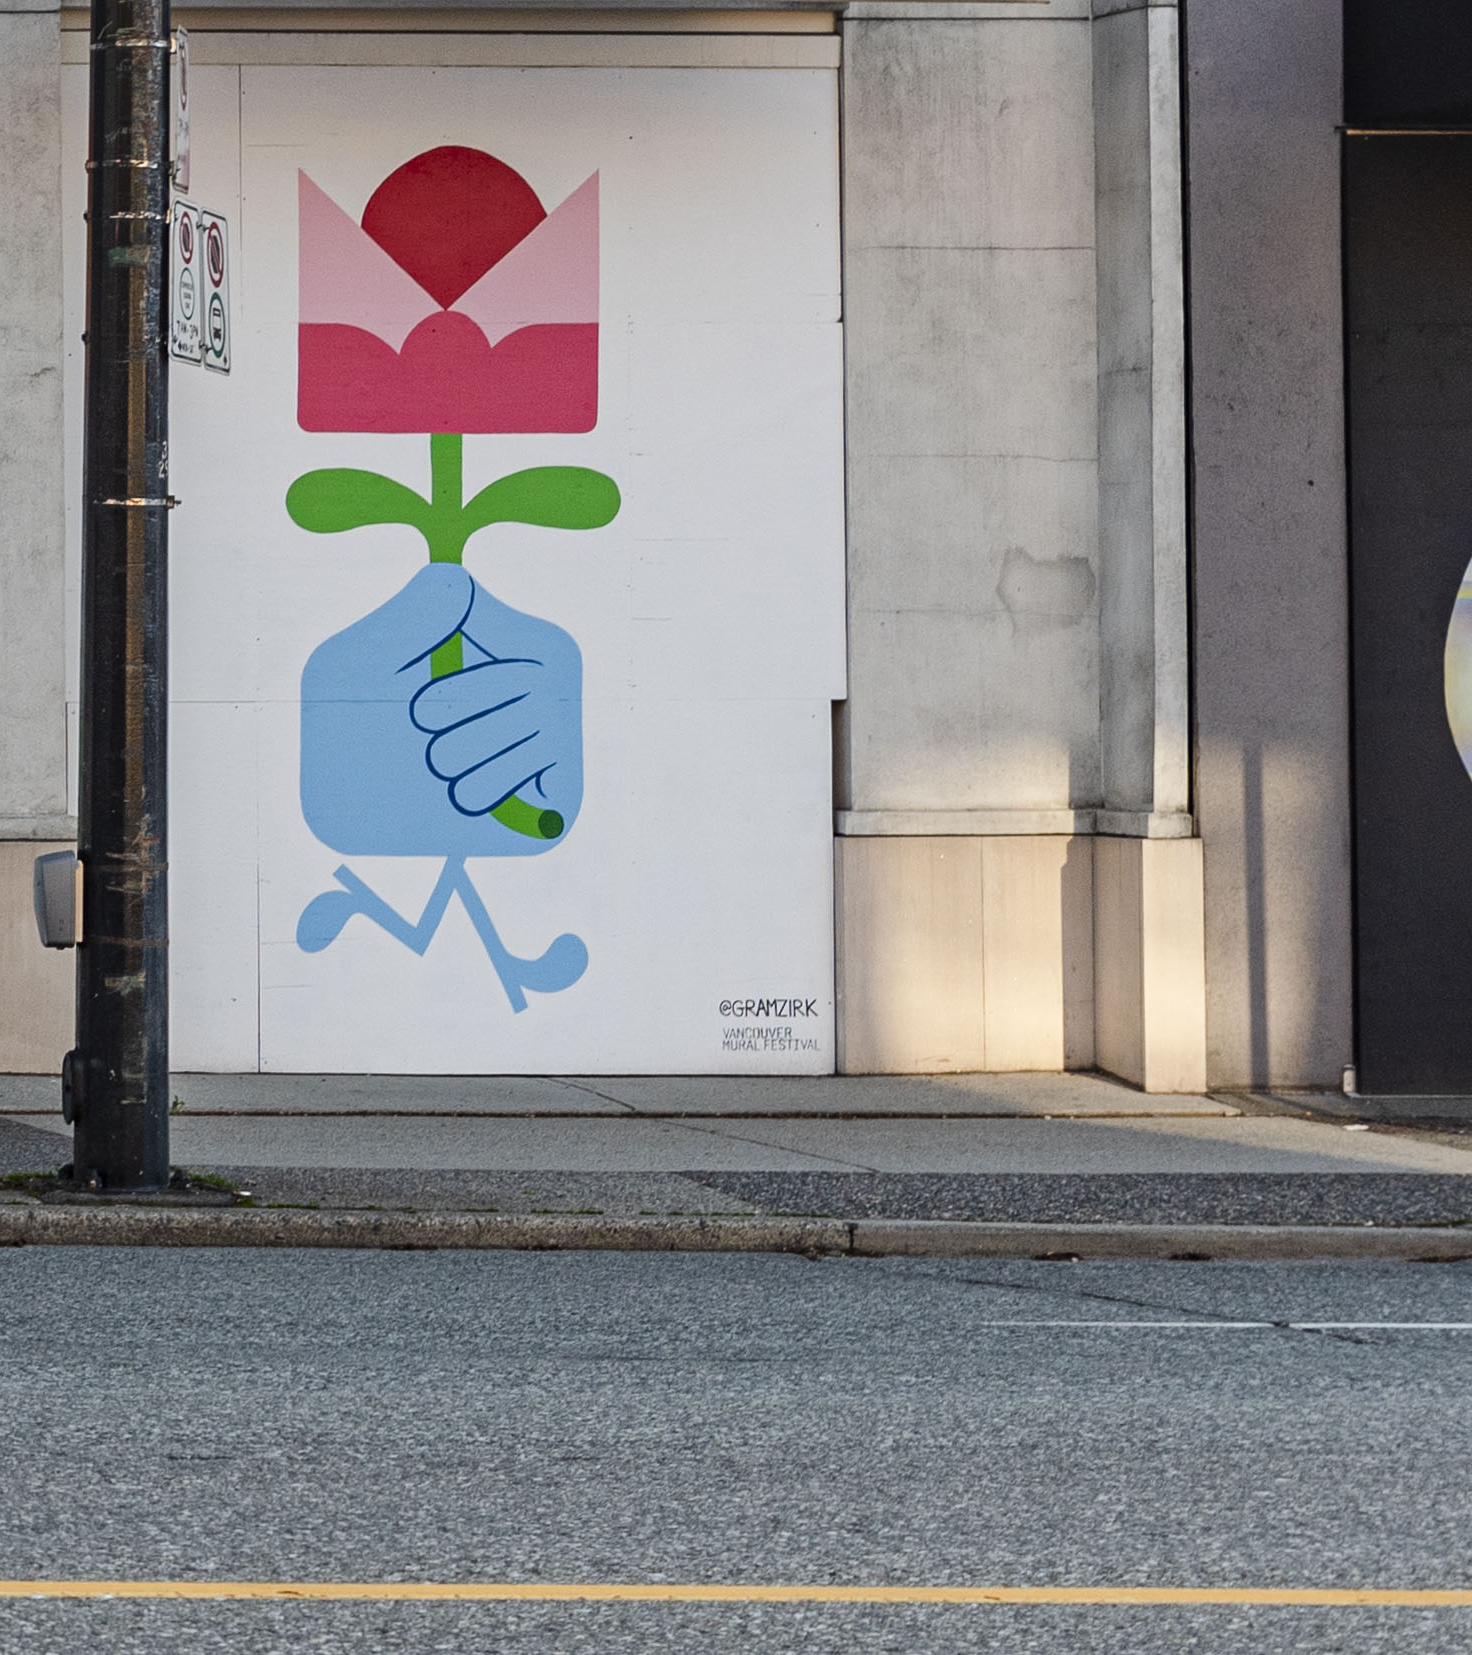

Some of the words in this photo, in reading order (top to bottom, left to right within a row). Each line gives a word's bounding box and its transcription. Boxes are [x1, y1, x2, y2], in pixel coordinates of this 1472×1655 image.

[719, 998, 818, 1017] @GRAMZIRK
[722, 1027, 792, 1039] VANCOUVER
[722, 1039, 760, 1051] MURAL
[764, 1039, 821, 1051] FESTIVAL
